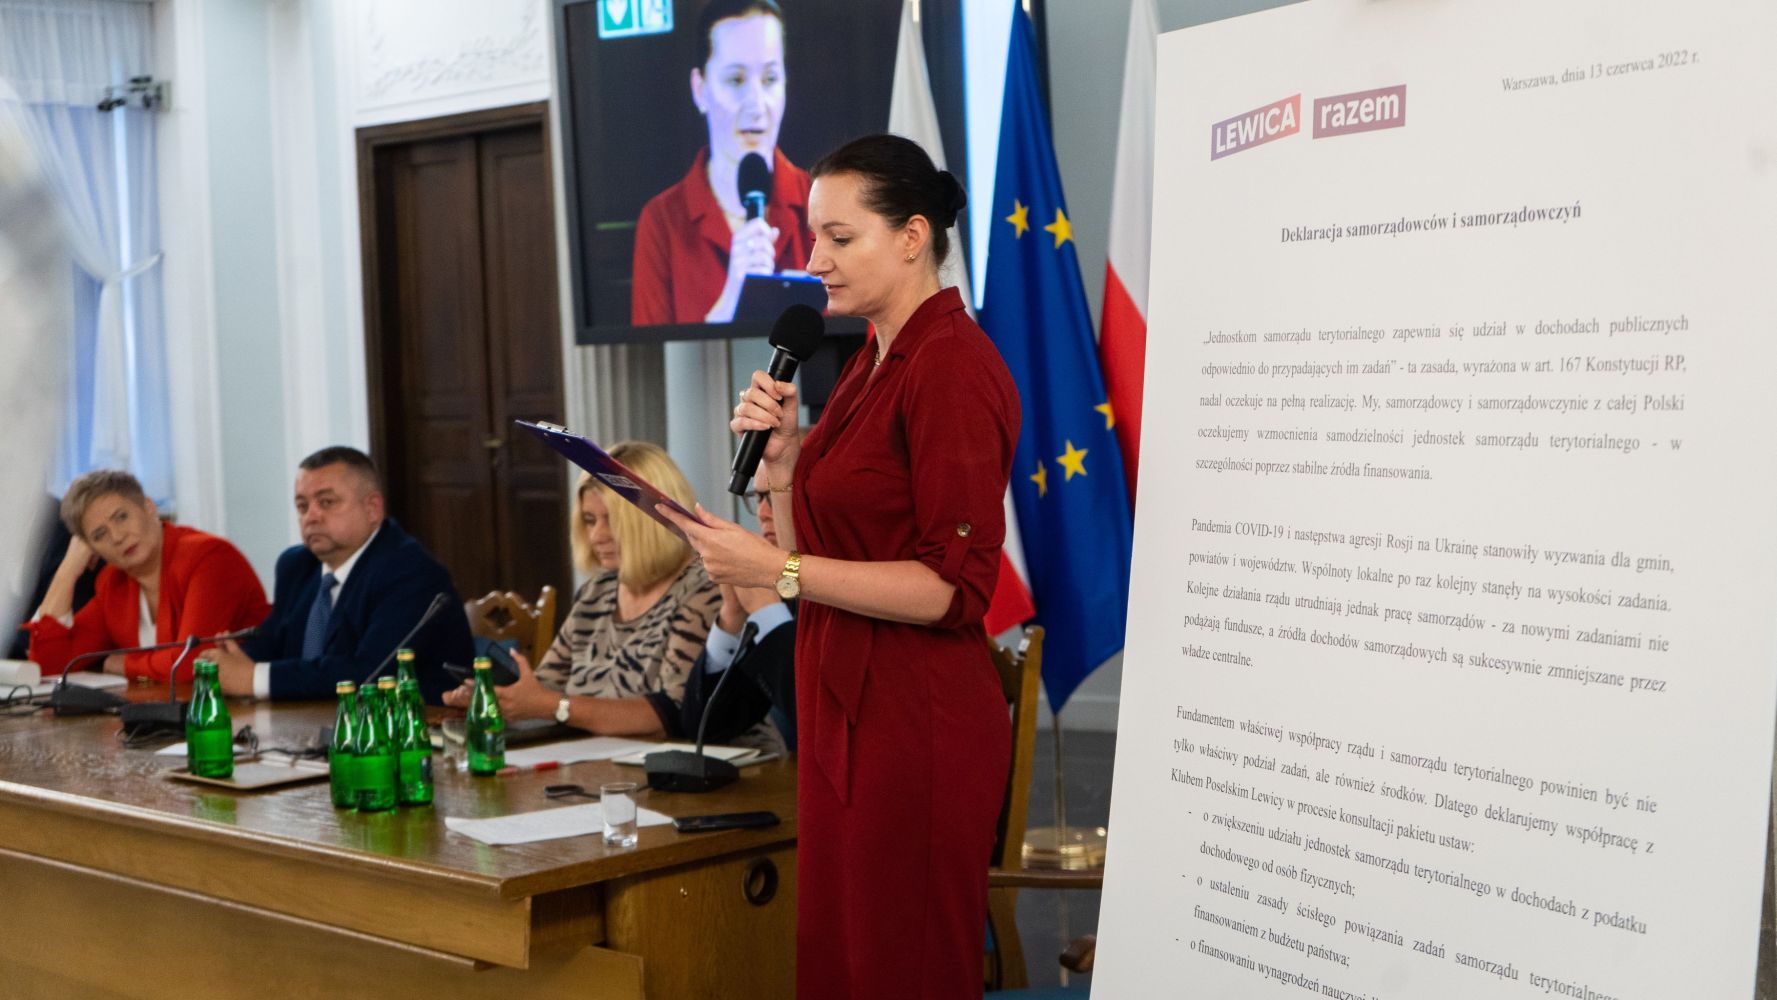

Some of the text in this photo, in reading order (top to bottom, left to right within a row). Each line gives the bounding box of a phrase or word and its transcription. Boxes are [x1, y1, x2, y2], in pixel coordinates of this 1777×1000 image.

[1502, 50, 1688, 91] Warszawa, dnia 13 czerwca 2022
[1215, 102, 1296, 154] LEWICA
[1321, 93, 1399, 129] razem
[1281, 200, 1581, 243] Deklaracja samorządowców i samorządowczyń
[1263, 328, 1311, 345] samorządu
[1318, 326, 1385, 344] terytorialnego
[1392, 324, 1441, 343] zapewnia
[1449, 323, 1464, 341] się
[1473, 321, 1507, 337] udział
[1534, 317, 1599, 335] dochodach
[1609, 314, 1688, 337] publicznych
[1201, 361, 1256, 379] odpowiednio
[1257, 361, 1270, 375] do
[1271, 360, 1343, 379] przypadających
[1346, 360, 1359, 374] im
[1408, 362, 1417, 374] ta
[1420, 358, 1459, 375] zasada,
[1535, 360, 1554, 372] art.
[1560, 356, 1582, 372] 167
[1586, 355, 1659, 376] Konstytucji
[1199, 393, 1222, 407] nadal
[1225, 393, 1263, 411] oczekuje
[1266, 397, 1278, 407] na
[1280, 393, 1306, 411] pełną
[1309, 393, 1357, 412] realizację.
[1386, 394, 1463, 413] samorządowcy
[1477, 394, 1588, 414] samorządowczynie
[1607, 394, 1637, 415] całej
[1643, 394, 1684, 411] Polski
[1197, 425, 1640, 454] oczekujemy wzmocnienia samodzielności jednostek samorządu terytorialnego
[1195, 457, 1433, 480] szczególności poprzez stabilne źródła finansowania.
[1191, 518, 1674, 573] Pandemia COVID-19 następstwa agresji Rosji na Ukrainę stanowiły wyzwania dla gmin,
[1188, 550, 1671, 612] powiatów województw. Wspólnoty lokalne po raz kolejny stanęły na wysokości zadania.
[1186, 580, 1669, 652] Kolejne działania rządu utrudniają jednak pracę samorządów za nowymi zadaniami nie
[1181, 643, 1253, 667] władze centralne.
[1183, 613, 1667, 693] podążają fundusze, a źródła dochodów samorządowych są sukcesywnie zmniejszane przez
[1176, 705, 1657, 813] Fundamentem właściwej współpracy rządu samorządu terytorialnego powinien być nie
[1171, 767, 1204, 788] Klubem
[1204, 776, 1249, 799] Poselskim
[1250, 786, 1285, 811] Lewicy
[1286, 799, 1296, 810] w
[1297, 802, 1337, 824] procesie
[1339, 807, 1394, 837] konsultacji
[1396, 823, 1436, 844] pakietu
[1173, 738, 1638, 855] tylko właściwy podział zadań, ale również środków. Dlatego deklarujemy współpracę
[1199, 840, 1356, 898] dochodowego od osób fizycznych;
[1203, 811, 1647, 935] o zwiększeniu udziału jednostek samorządu terytorialnego w dochodach z podatku
[1193, 904, 1350, 968] finansowaniem budżetu państwa;
[1196, 876, 1519, 981] o ustaleniu zasady ścisłego powiązania zadań samorządu
[1198, 939, 1320, 993] finansowaniu wynagrodzeń
